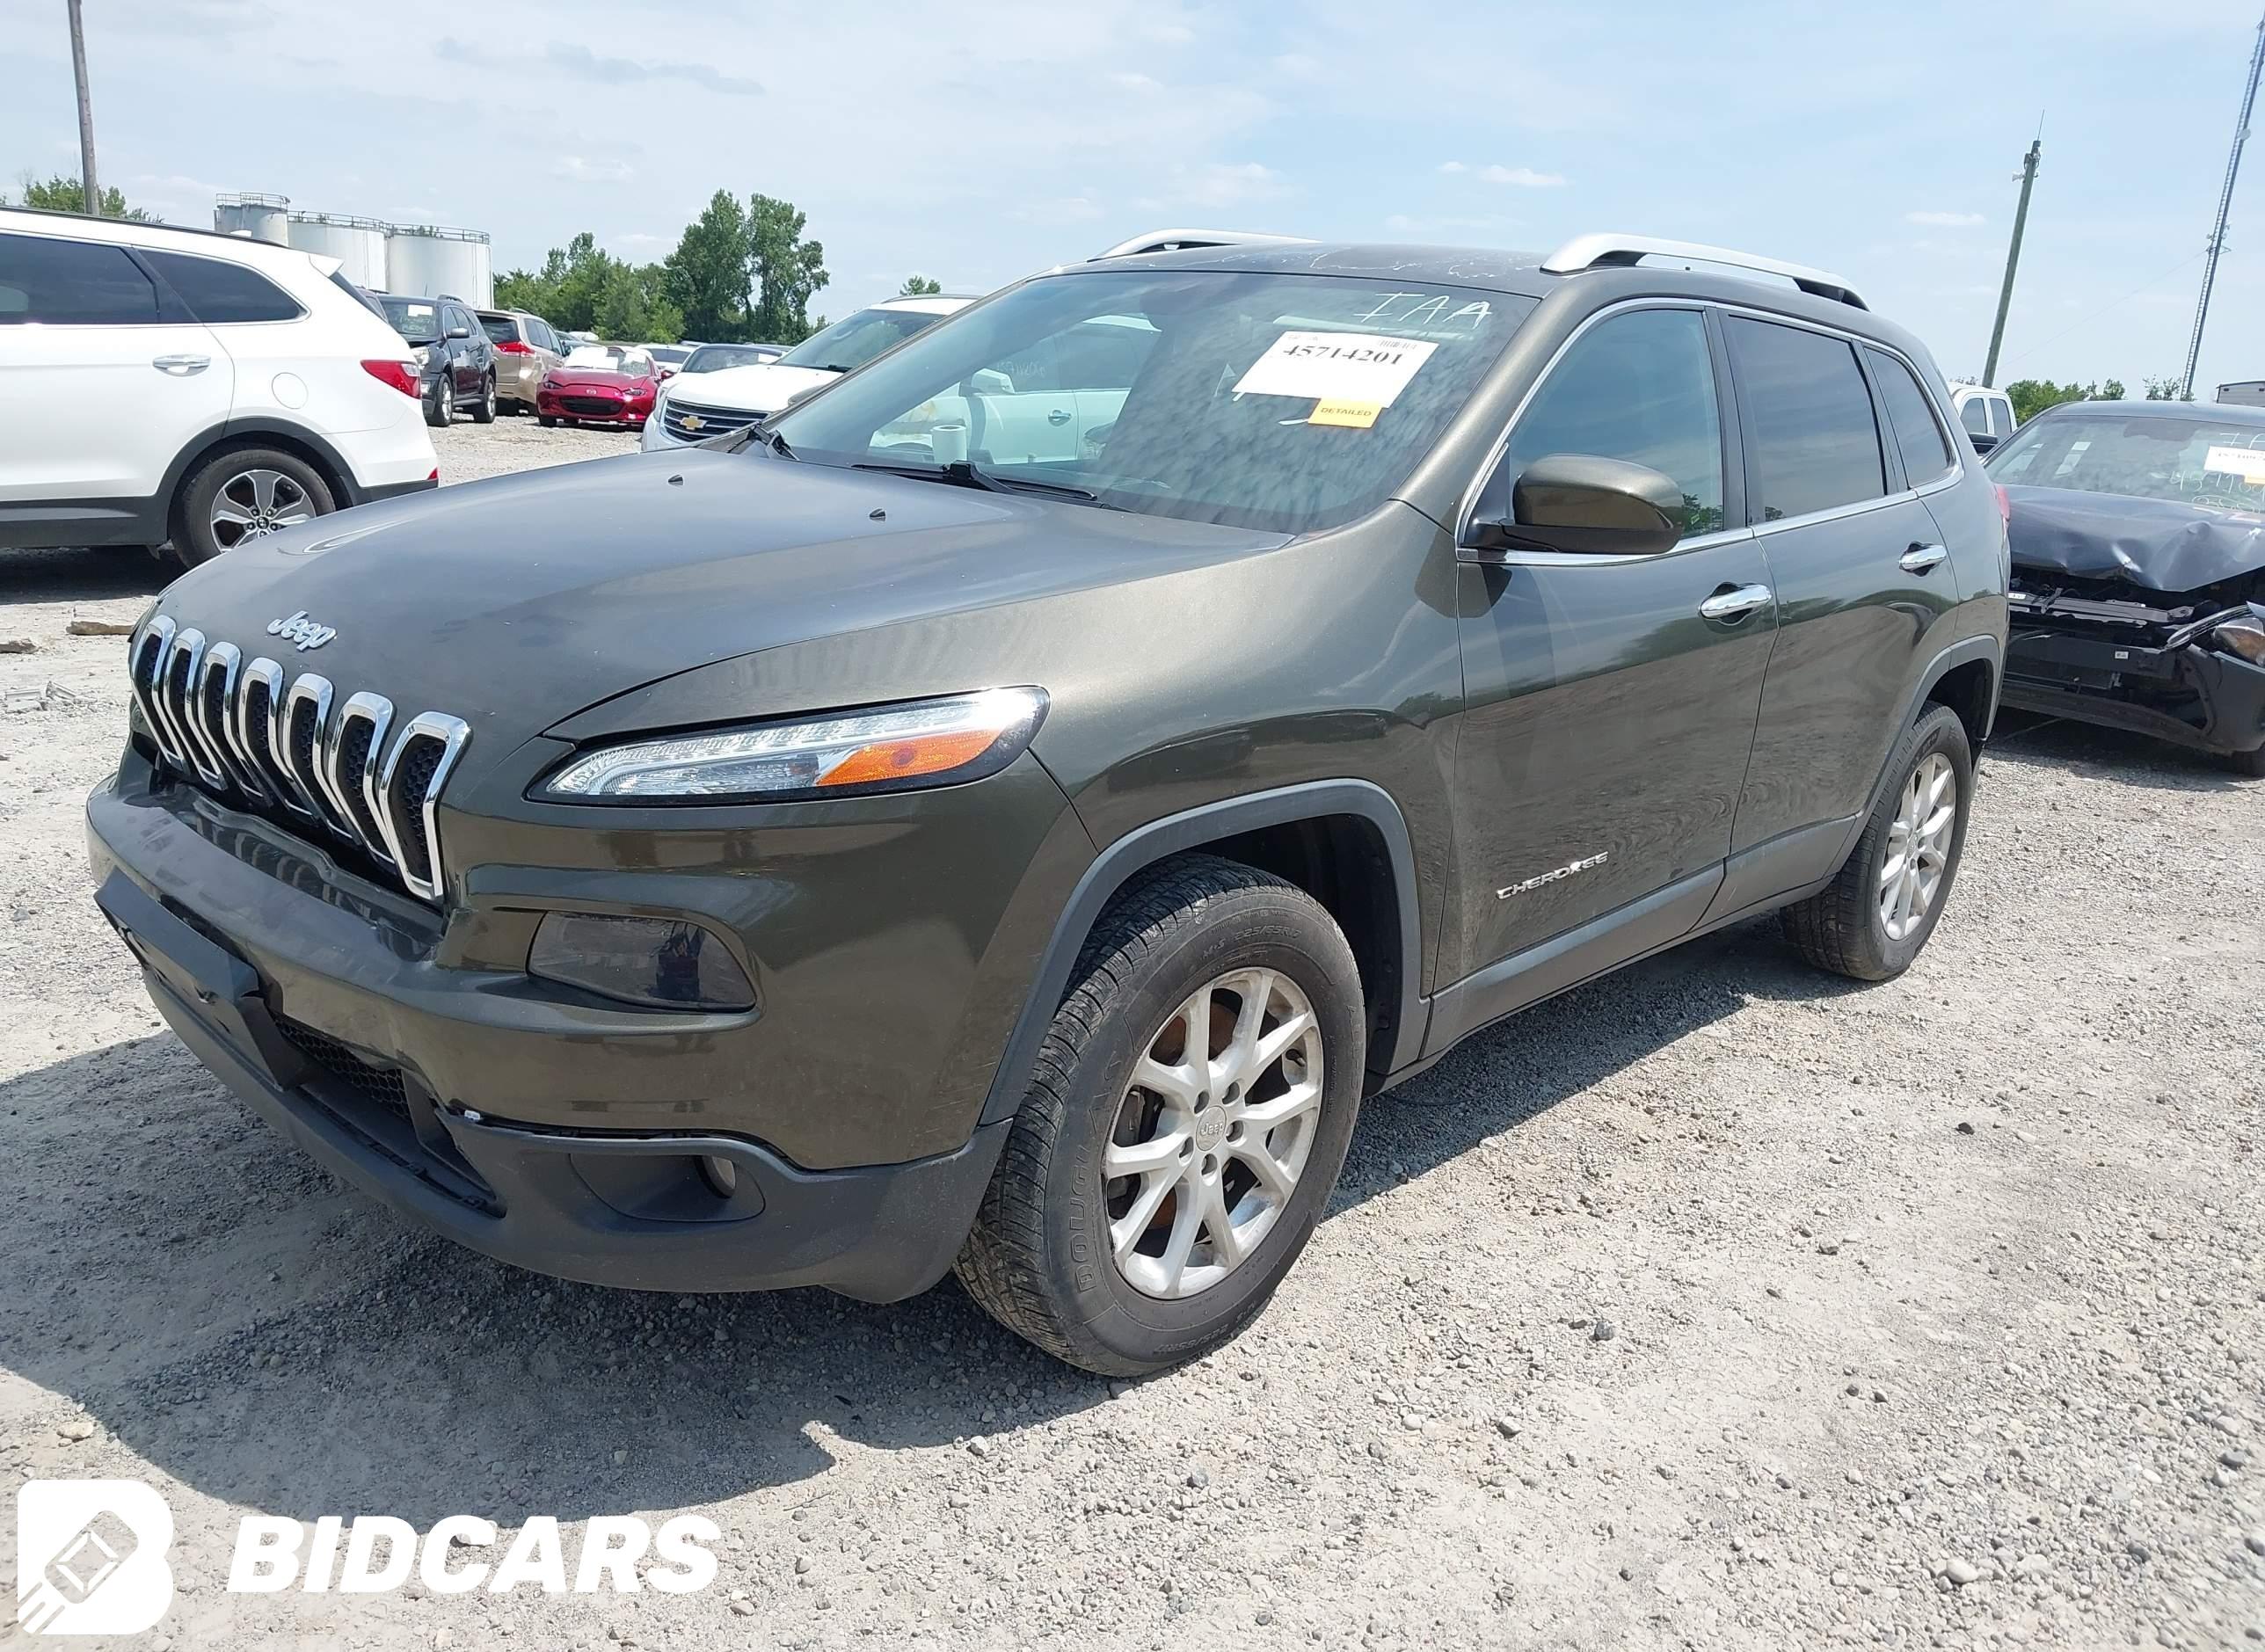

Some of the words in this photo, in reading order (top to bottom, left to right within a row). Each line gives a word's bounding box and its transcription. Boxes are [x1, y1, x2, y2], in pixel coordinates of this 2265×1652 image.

[1354, 291, 1492, 330] IAA
[1283, 345, 1403, 366] 45714201
[1321, 407, 1373, 418] DETAILED
[266, 610, 338, 651] Jeep
[1496, 850, 1609, 899] CHEROKEE
